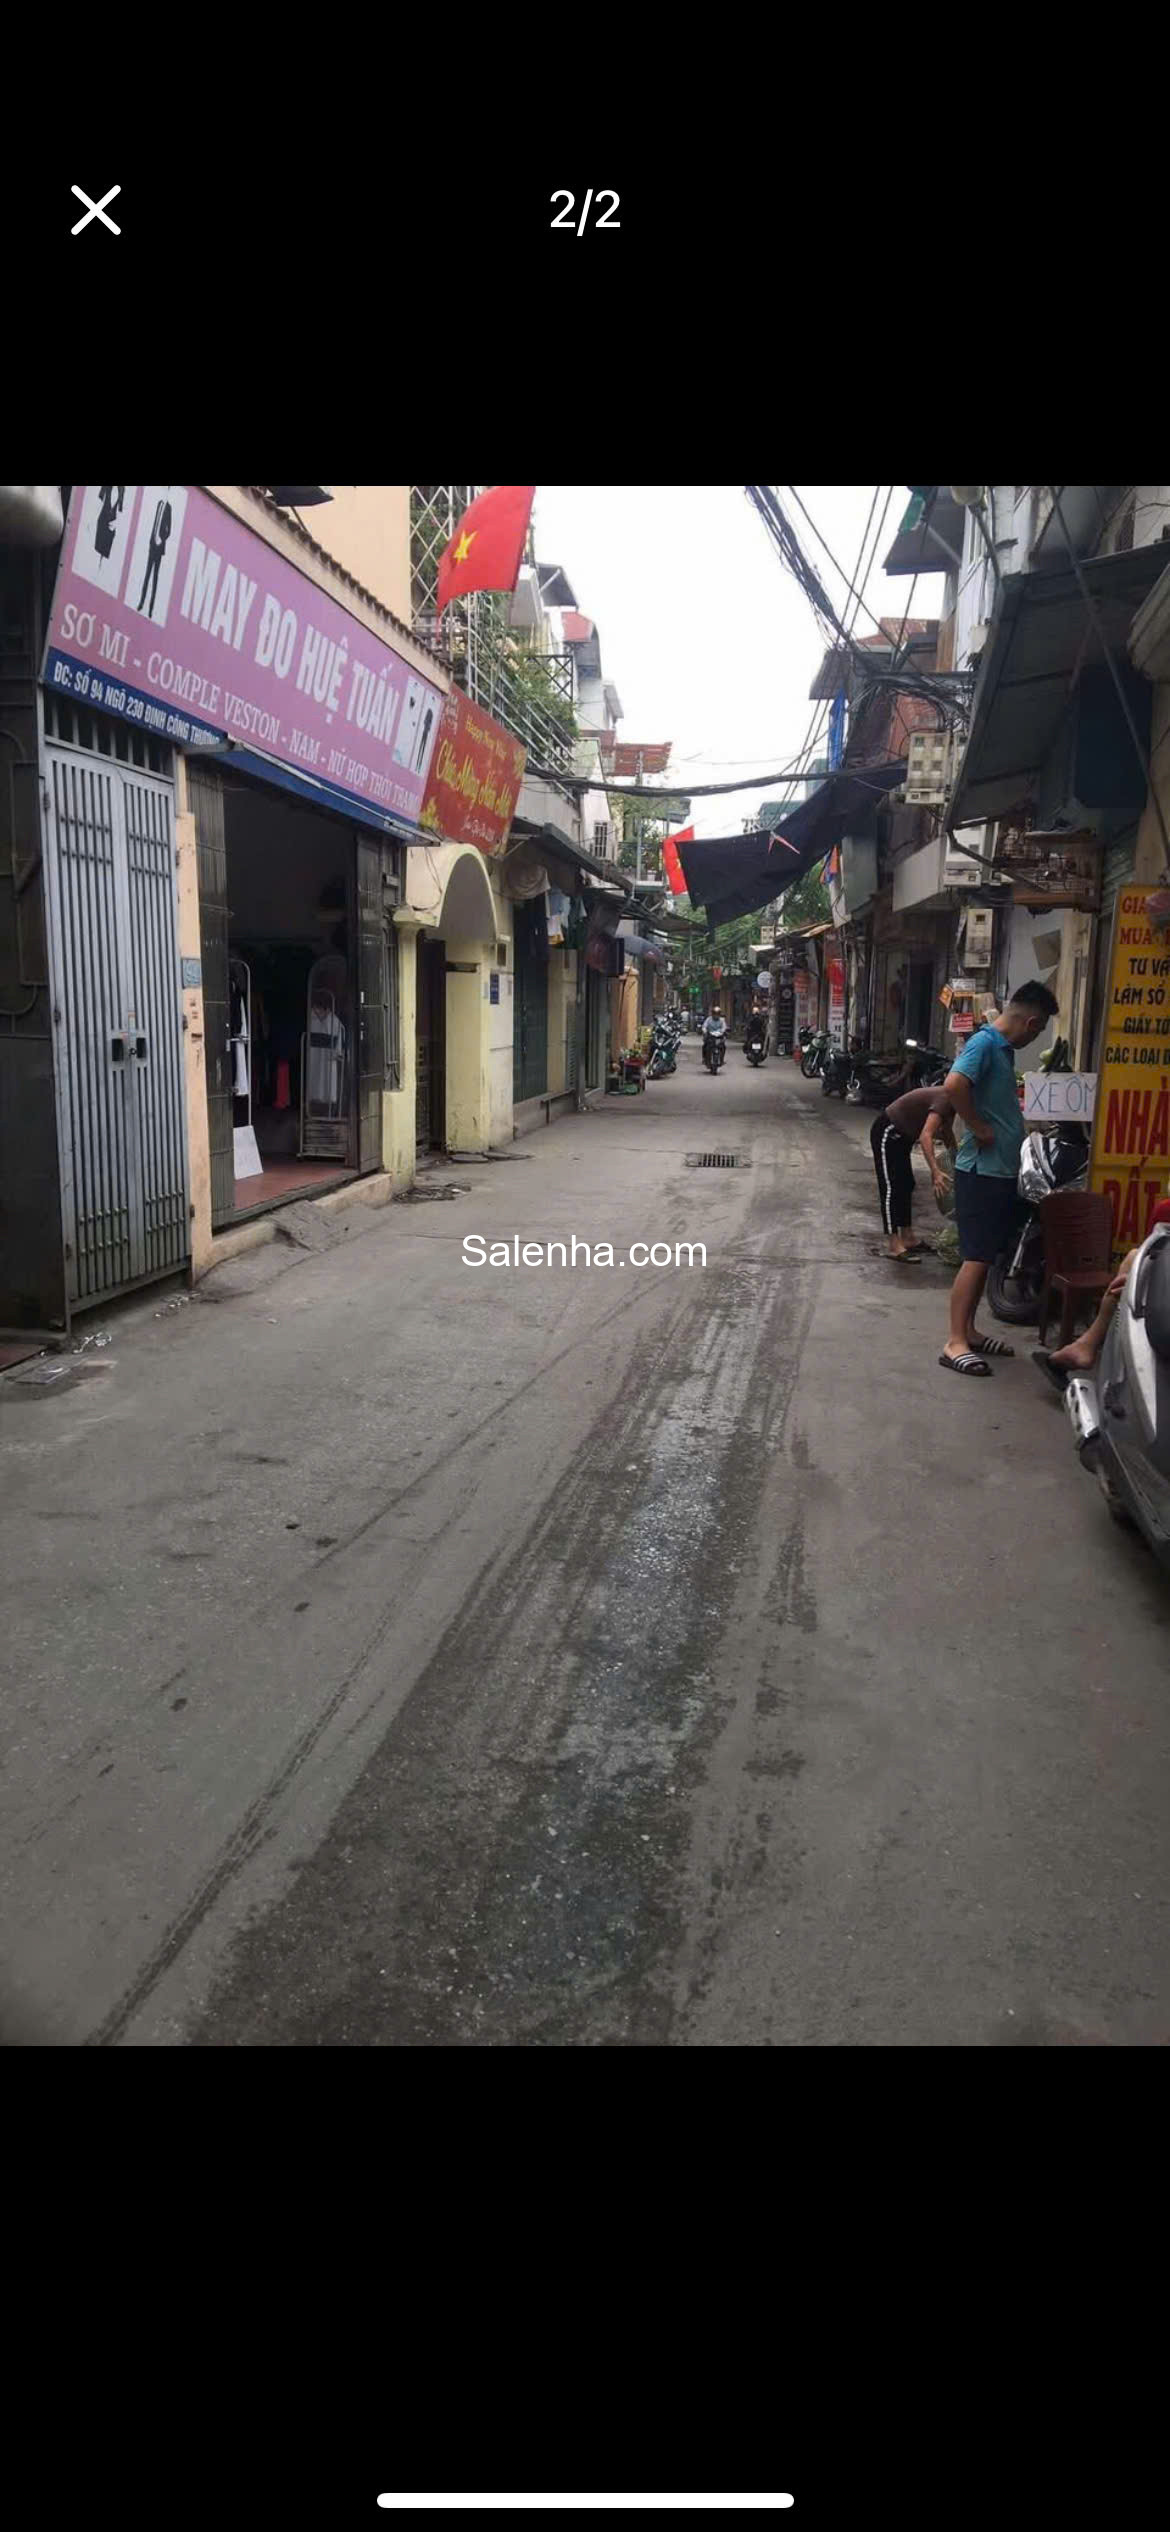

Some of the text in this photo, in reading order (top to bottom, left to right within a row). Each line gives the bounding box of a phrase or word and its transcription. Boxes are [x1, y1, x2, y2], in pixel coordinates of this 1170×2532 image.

[180, 536, 258, 652] MAY
[254, 593, 298, 679] ĐO
[296, 623, 349, 724] HUỆ
[346, 659, 400, 745] TUẤN
[53, 660, 73, 687] ĐC:
[74, 668, 92, 695] SỐ
[90, 680, 102, 700] 94
[126, 696, 145, 720] 230
[60, 603, 97, 648] SƠ
[99, 623, 131, 668] MI
[146, 651, 221, 714] COMPLE
[223, 691, 281, 744] VESTON
[288, 728, 321, 764] NAM
[1119, 927, 1152, 945] MUA
[1105, 1044, 1130, 1064] CÁC
[1103, 1075, 1170, 1156] NHÀ
